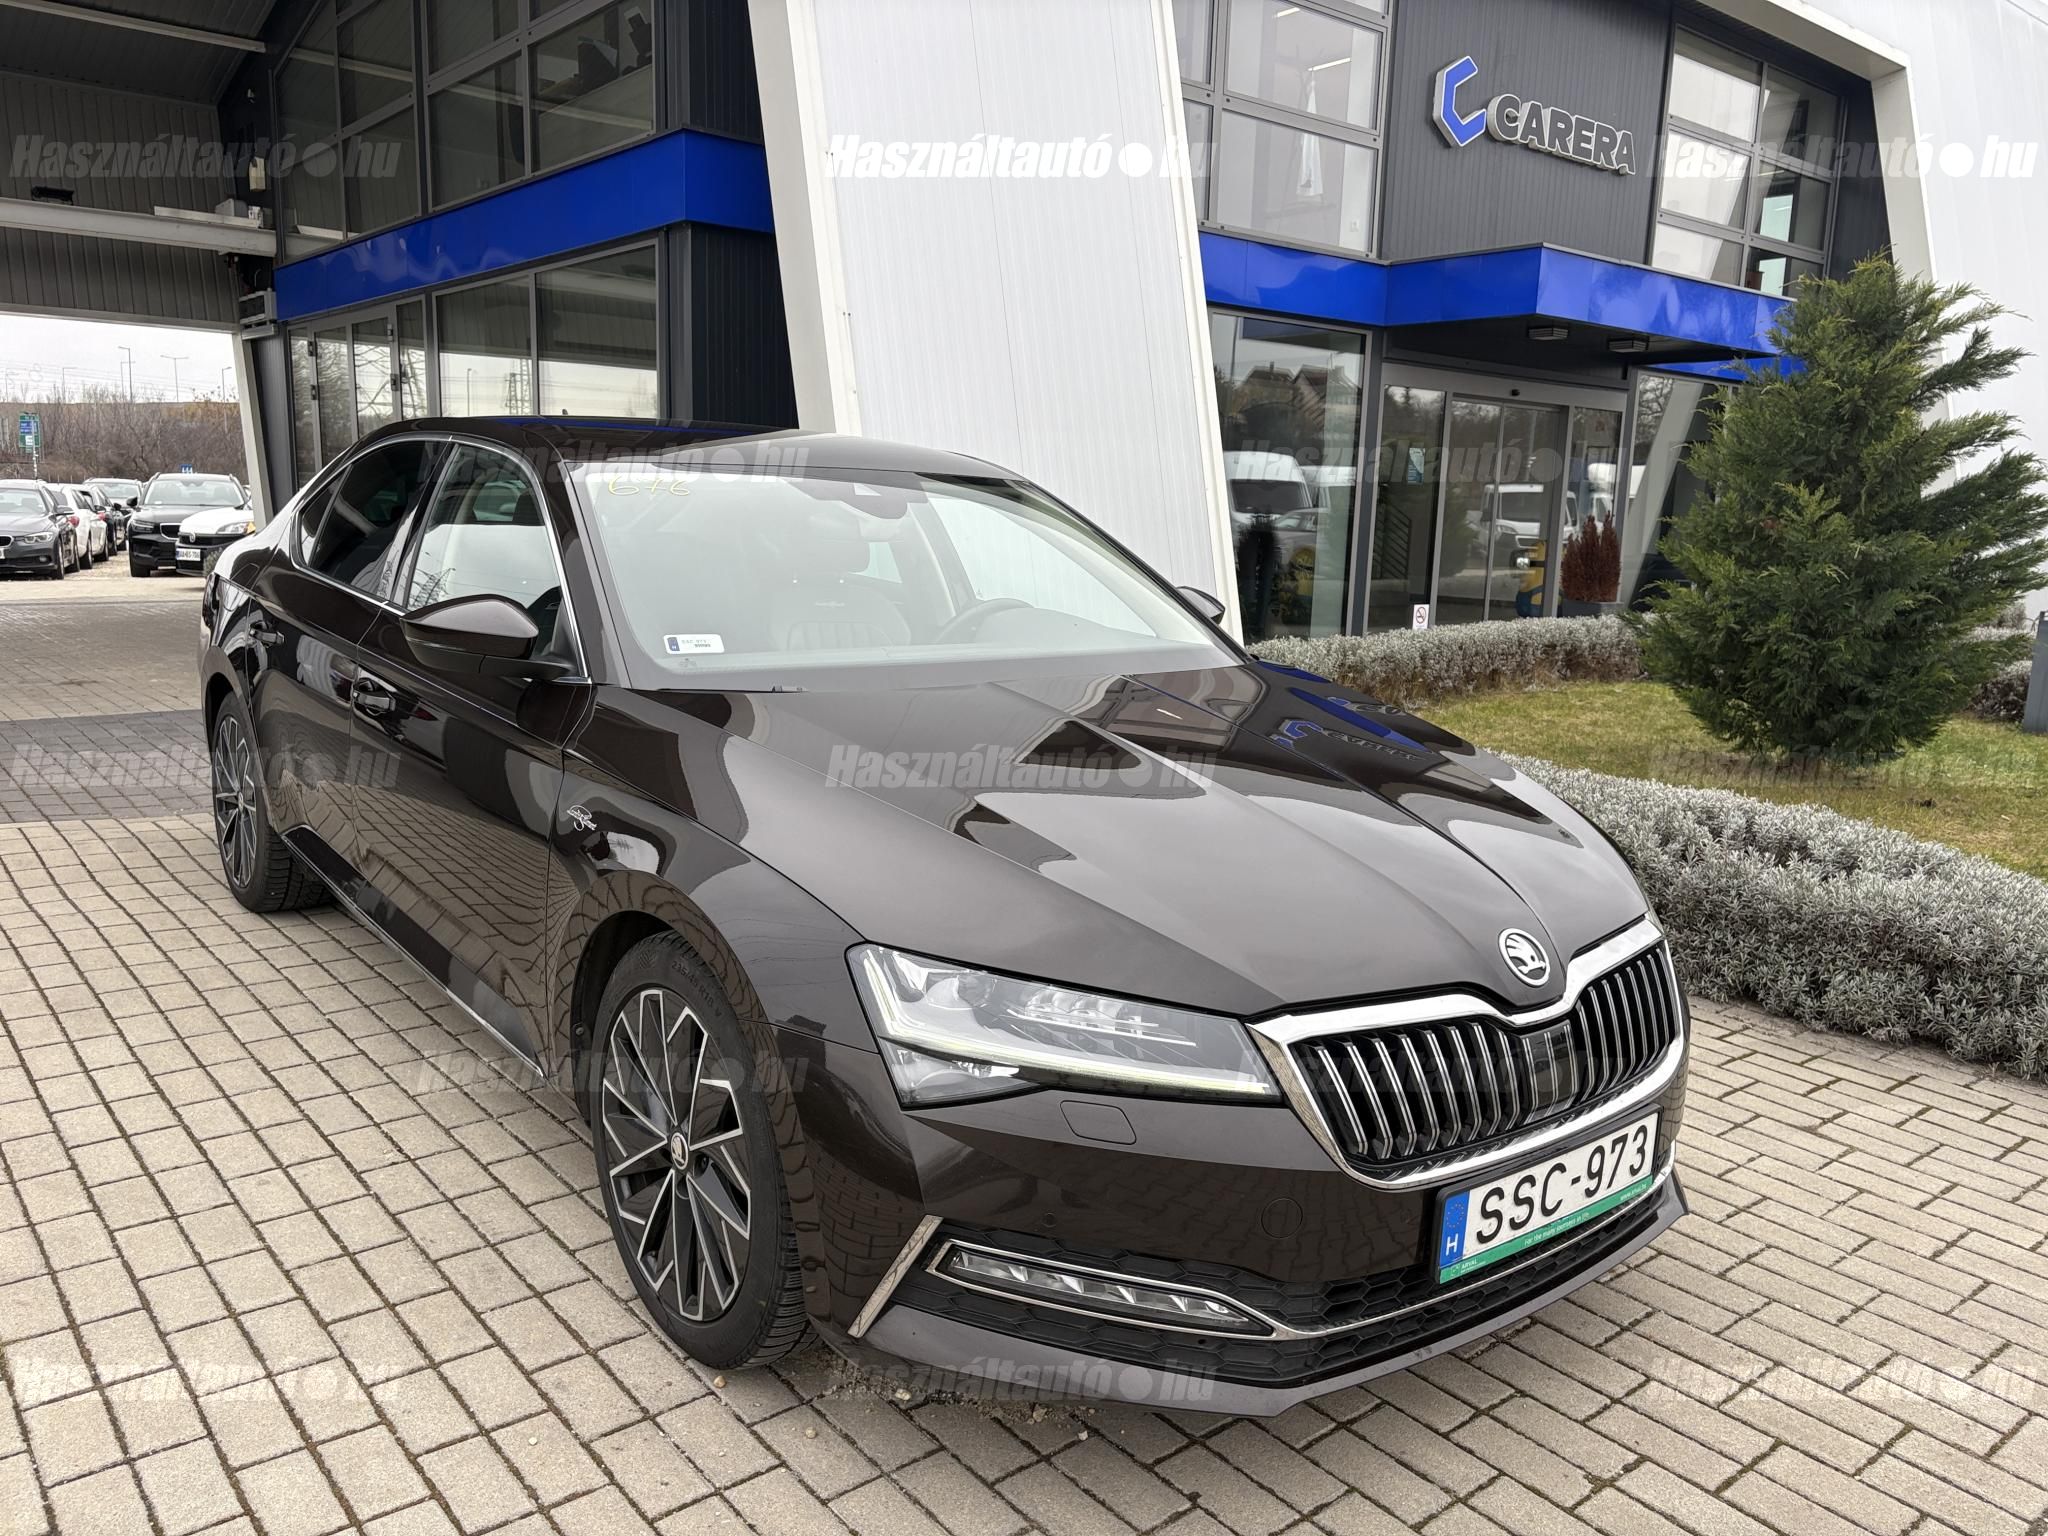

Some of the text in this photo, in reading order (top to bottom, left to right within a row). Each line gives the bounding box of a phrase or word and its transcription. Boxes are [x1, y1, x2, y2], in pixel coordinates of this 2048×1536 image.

[1488, 93, 1636, 175] CARERA
[1476, 1124, 1648, 1244] SSC-973
[1445, 1232, 1458, 1257] H
